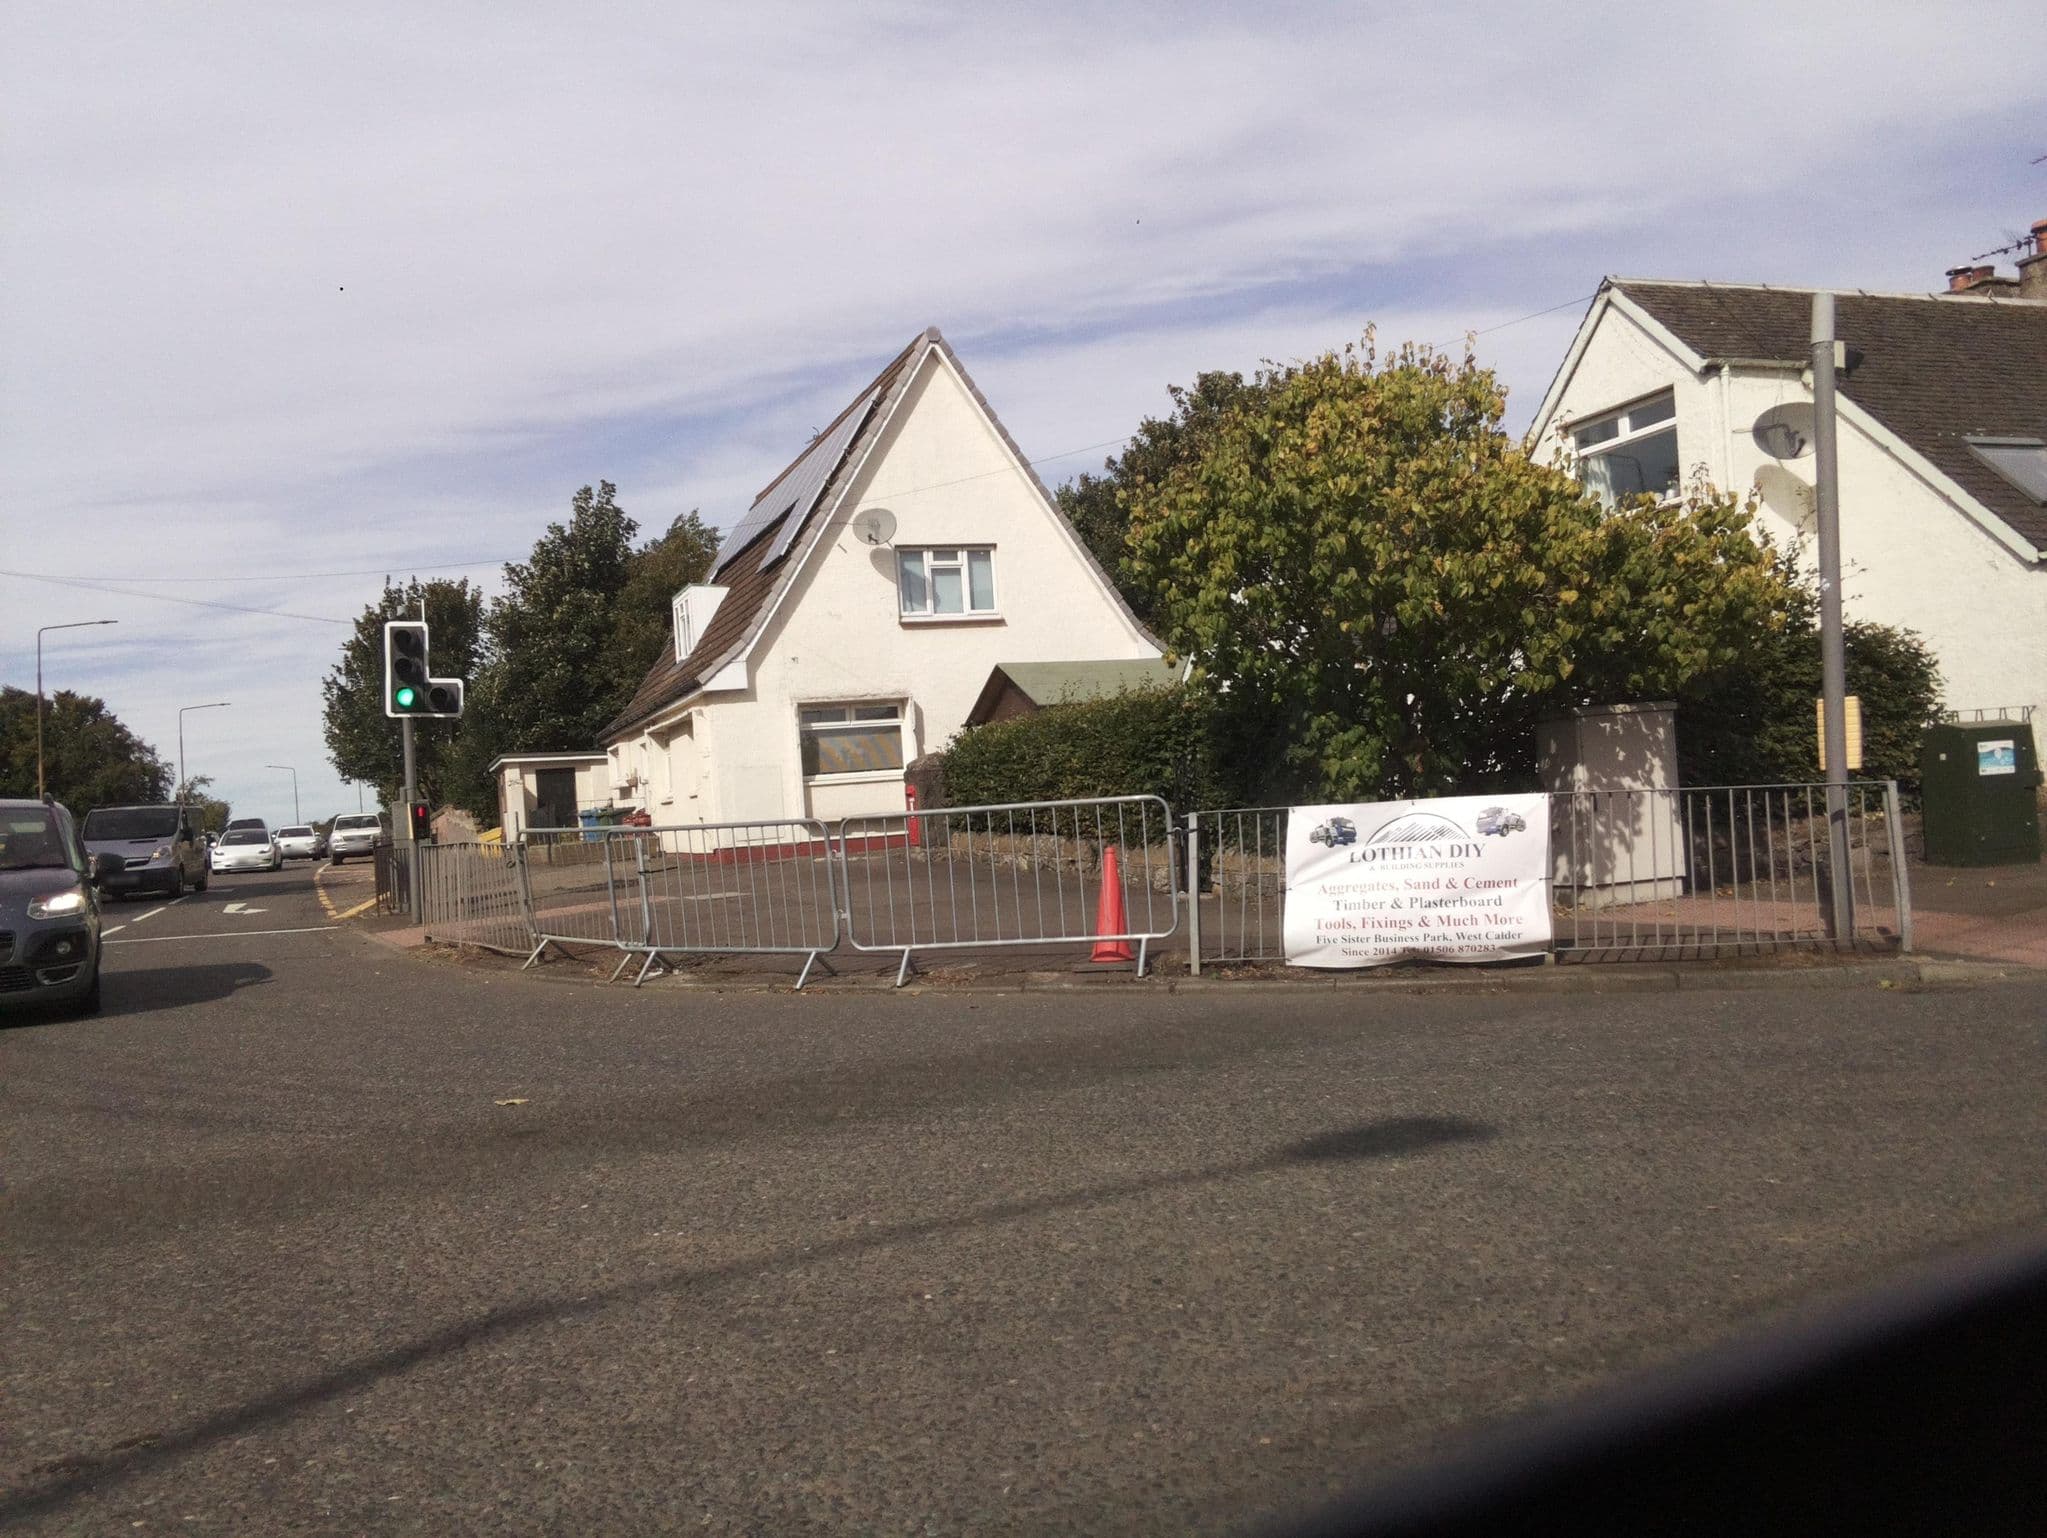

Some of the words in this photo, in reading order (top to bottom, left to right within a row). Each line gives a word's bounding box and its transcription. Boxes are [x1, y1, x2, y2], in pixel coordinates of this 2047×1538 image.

[1350, 845, 1442, 863] LOTHIAN
[1449, 843, 1486, 858] DIY
[1424, 861, 1465, 870] SUPPLIES
[1318, 881, 1399, 896] Aggregates,
[1403, 878, 1440, 891] Sand
[1446, 877, 1459, 890] &
[1463, 876, 1518, 890] Cement
[1332, 899, 1386, 911] Timber
[1391, 897, 1403, 910] &
[1409, 895, 1503, 909] Plasterboard
[1315, 917, 1356, 930] Tools,
[1361, 915, 1413, 931] Fixings
[1418, 915, 1431, 928] &
[1438, 914, 1479, 927] Much
[1485, 913, 1523, 926] More
[1316, 935, 1339, 944] Five
[1341, 934, 1371, 944] Sister
[1374, 933, 1419, 943] Business
[1423, 932, 1453, 942] Park,
[1456, 931, 1481, 941] West
[1485, 930, 1523, 940] Calder
[1341, 947, 1370, 957] Since
[1373, 946, 1397, 956] 2014
[1458, 944, 1496, 953] 870283
